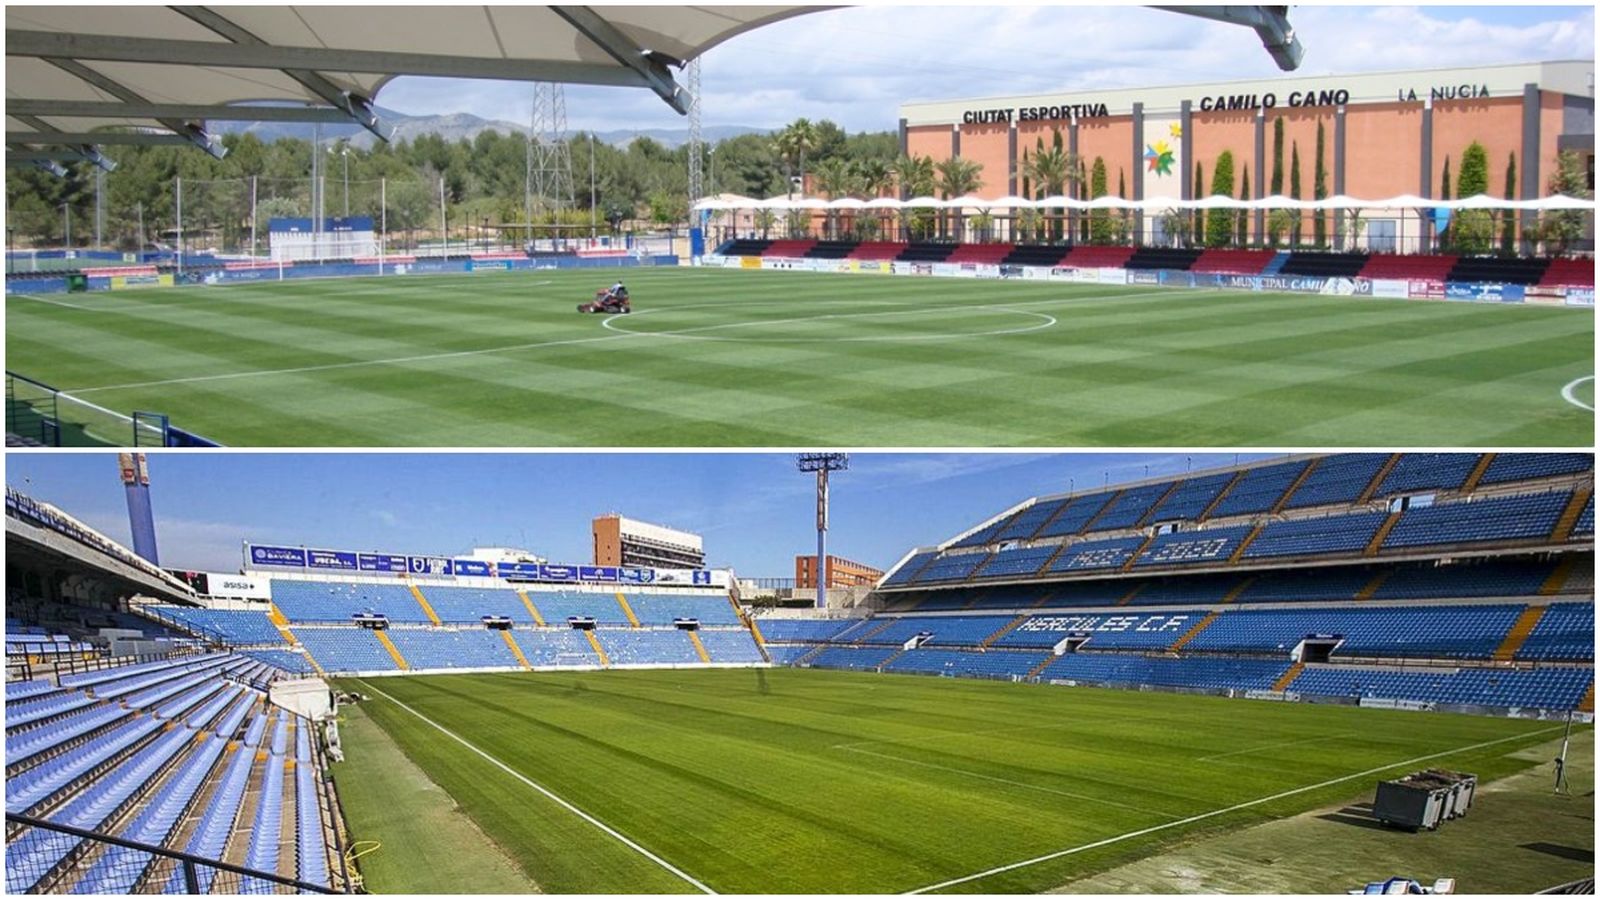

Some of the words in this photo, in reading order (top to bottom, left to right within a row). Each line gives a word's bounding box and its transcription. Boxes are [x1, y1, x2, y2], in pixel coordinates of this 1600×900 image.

[1200, 92, 1276, 111] CAMILO
[1289, 89, 1349, 107] CANO
[1398, 88, 1417, 101] LA
[1431, 84, 1490, 100] NUCIA
[963, 108, 1015, 124] CIUTAT
[1019, 103, 1109, 121] ESPORTIVA
[223, 581, 249, 589] asisa
